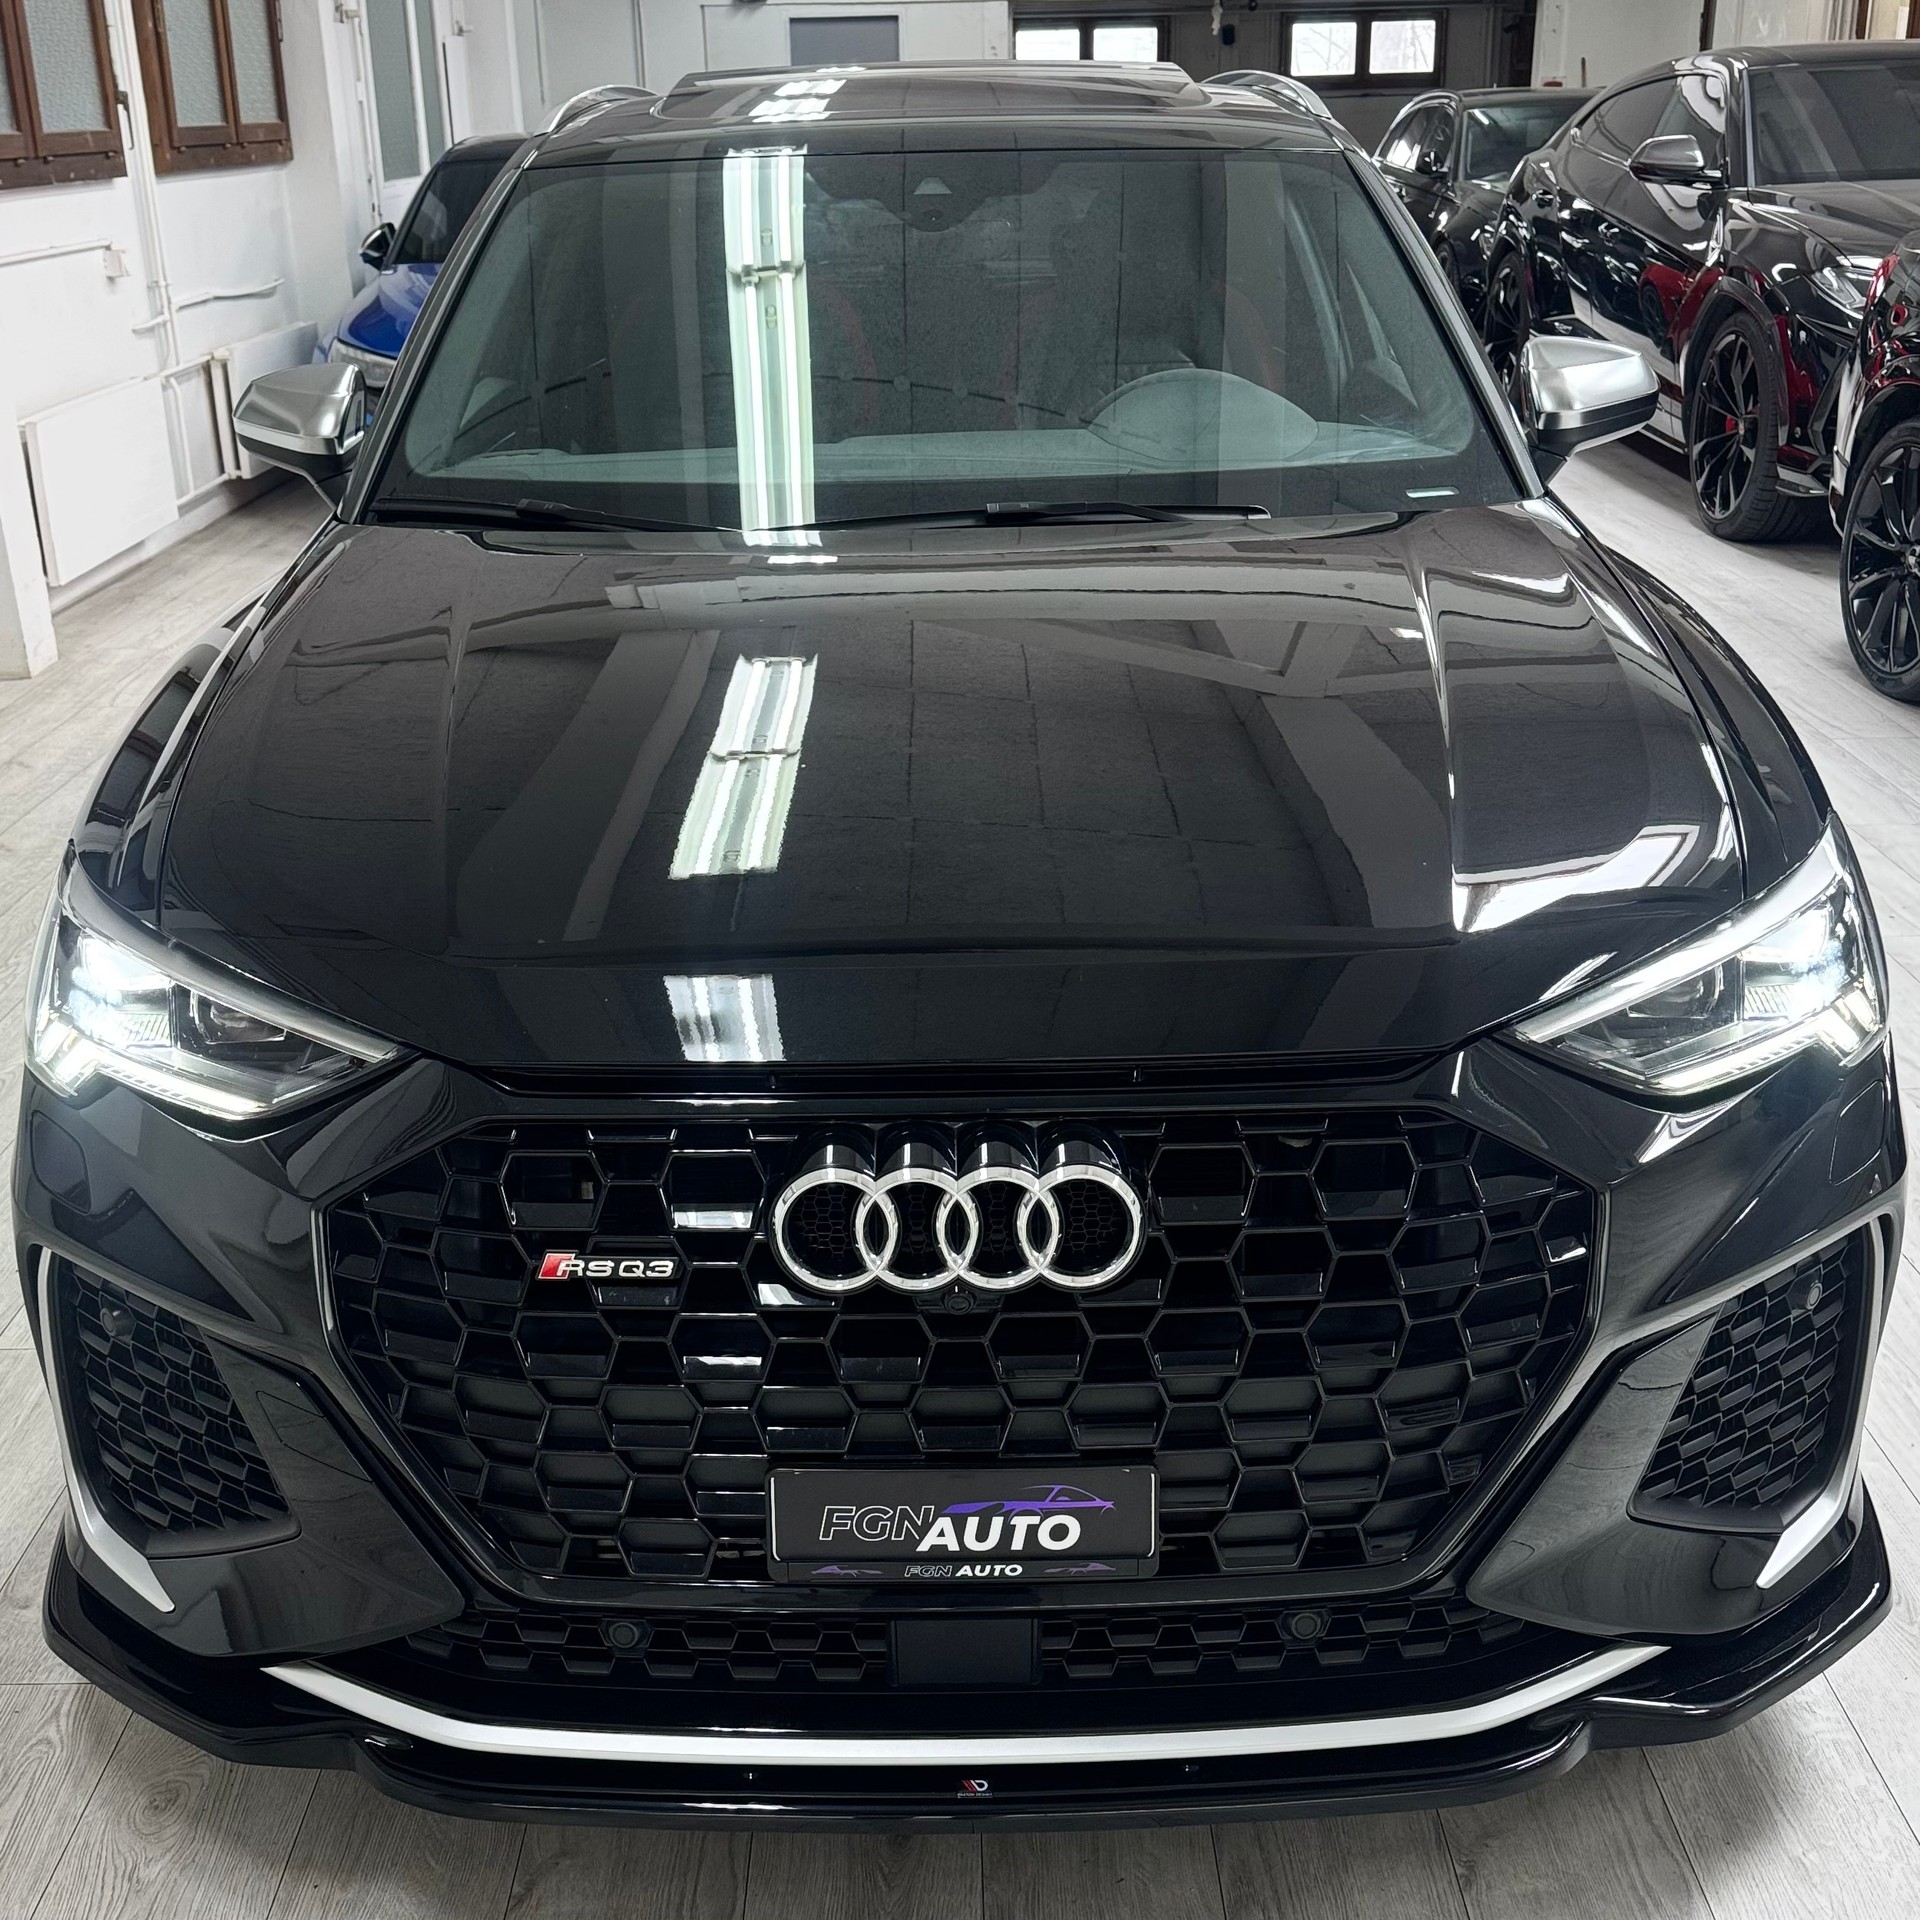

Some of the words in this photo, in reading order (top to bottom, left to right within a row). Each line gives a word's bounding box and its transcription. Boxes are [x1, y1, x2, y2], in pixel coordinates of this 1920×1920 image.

[819, 1505, 935, 1541] FGN
[915, 1514, 1082, 1552] AUTO
[904, 1565, 952, 1578] FGN
[955, 1564, 1023, 1577] AUTO
